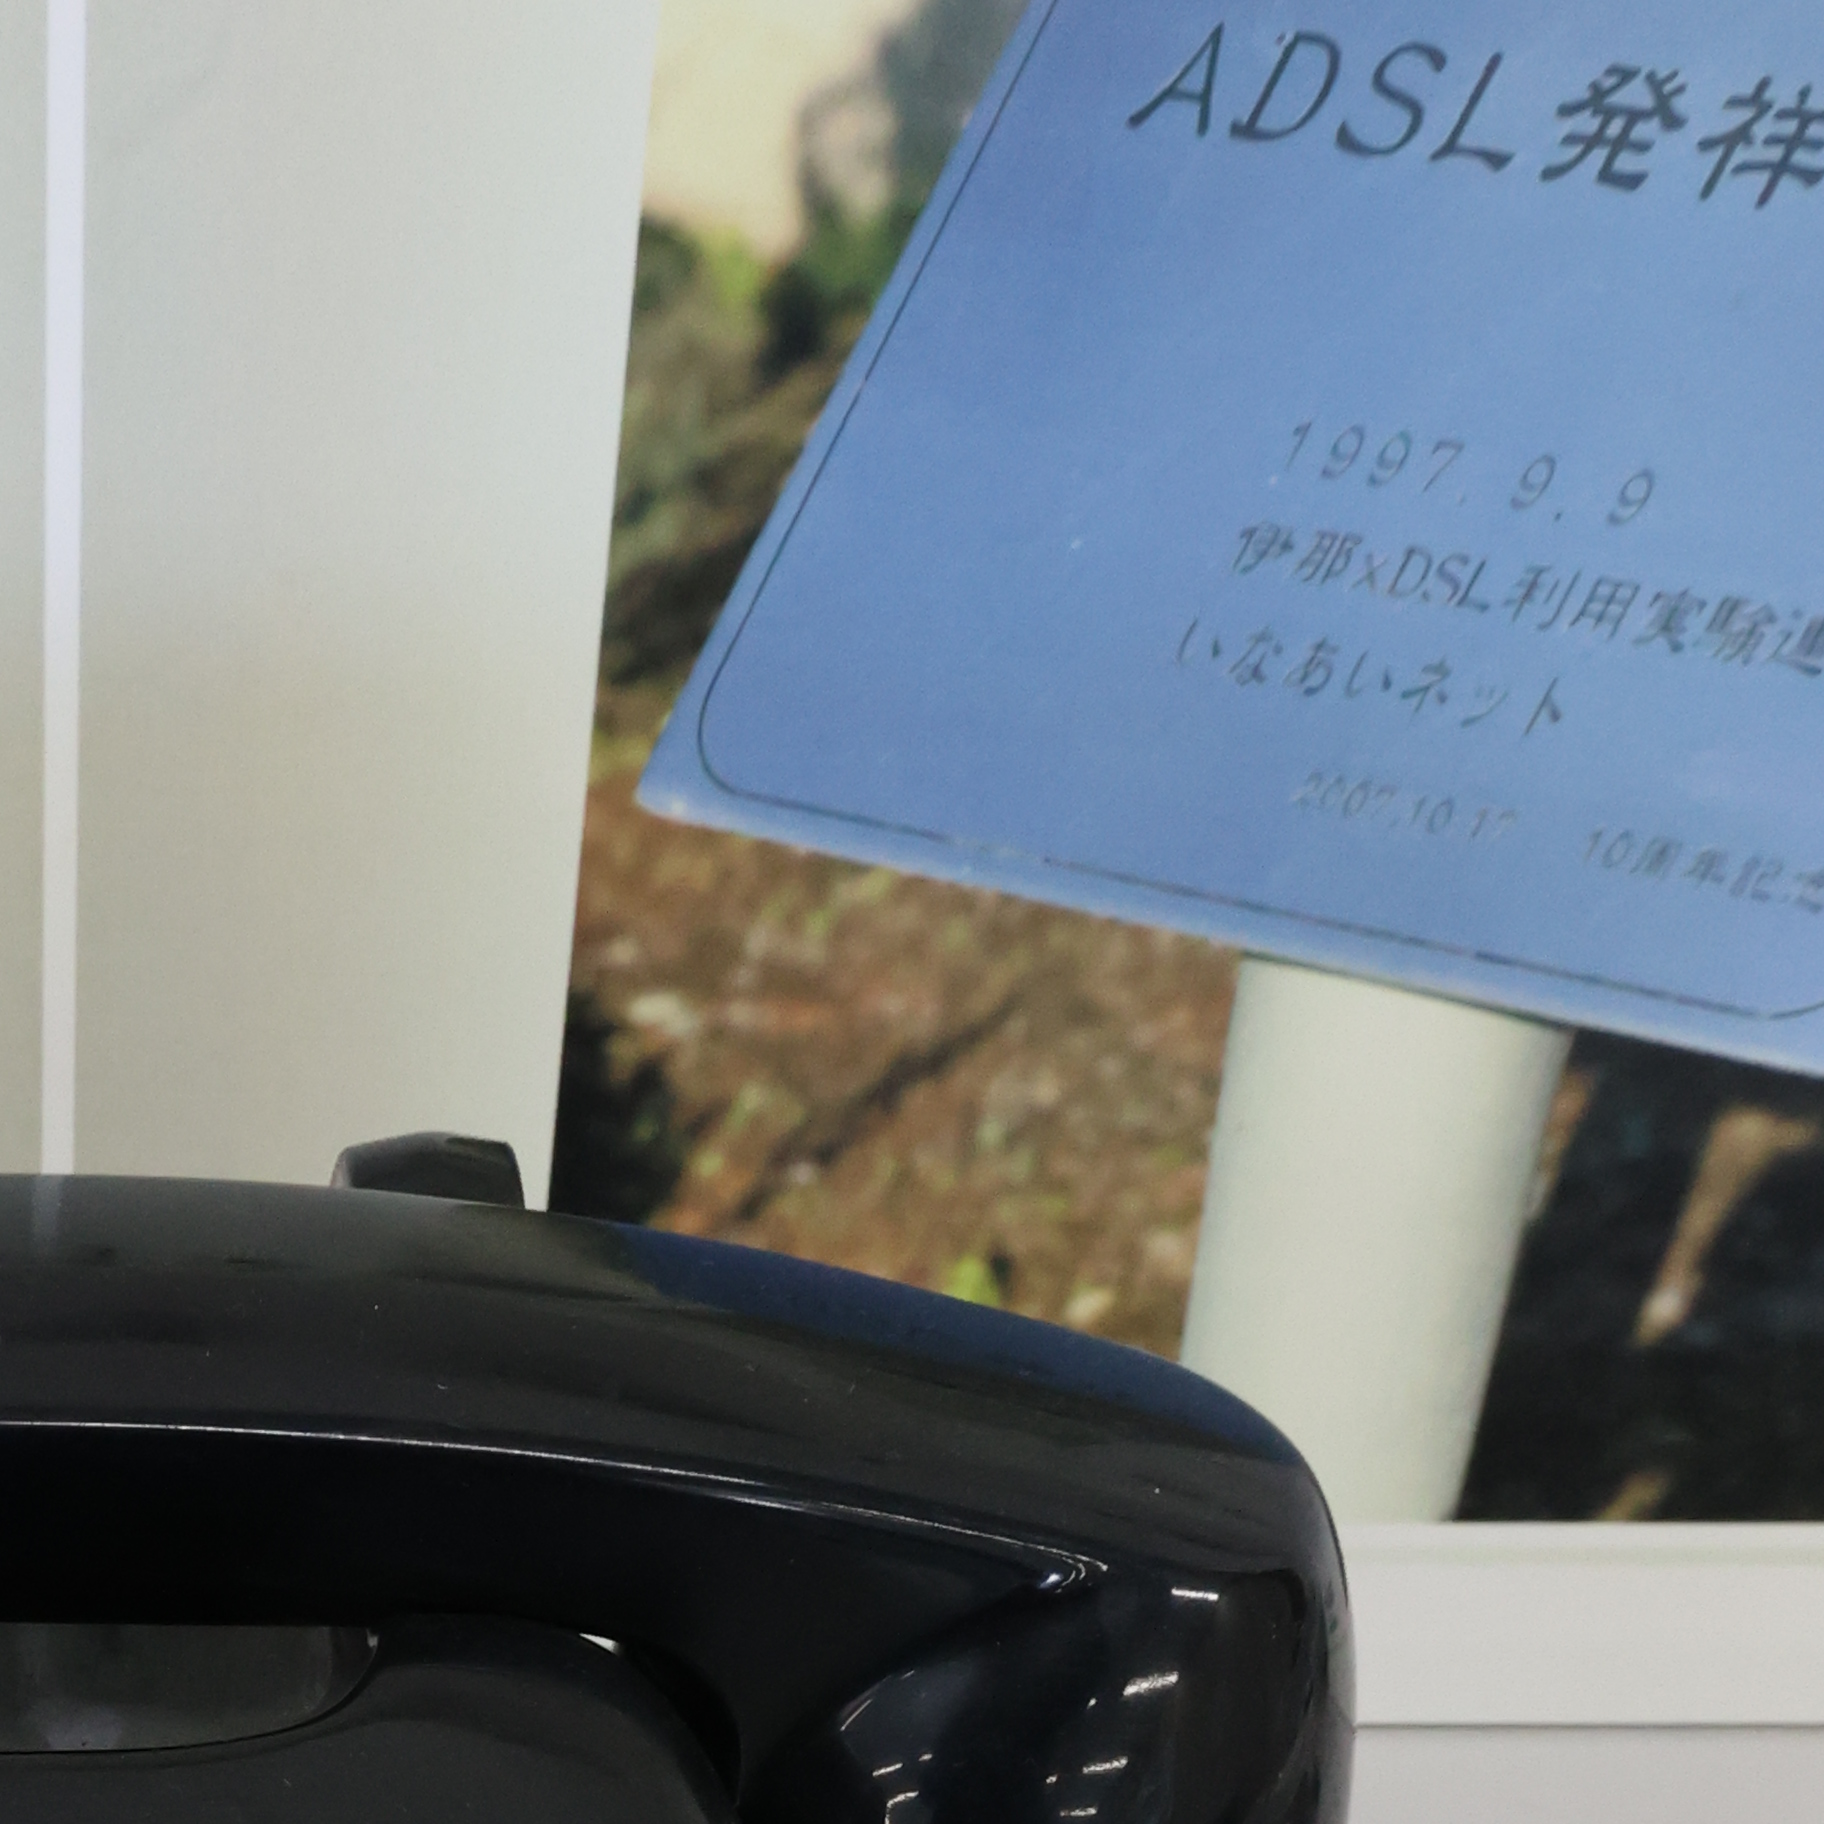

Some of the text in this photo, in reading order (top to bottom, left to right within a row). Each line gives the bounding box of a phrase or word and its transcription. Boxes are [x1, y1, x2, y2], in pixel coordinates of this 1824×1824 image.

[1176, 617, 1562, 738] いなあいネット
